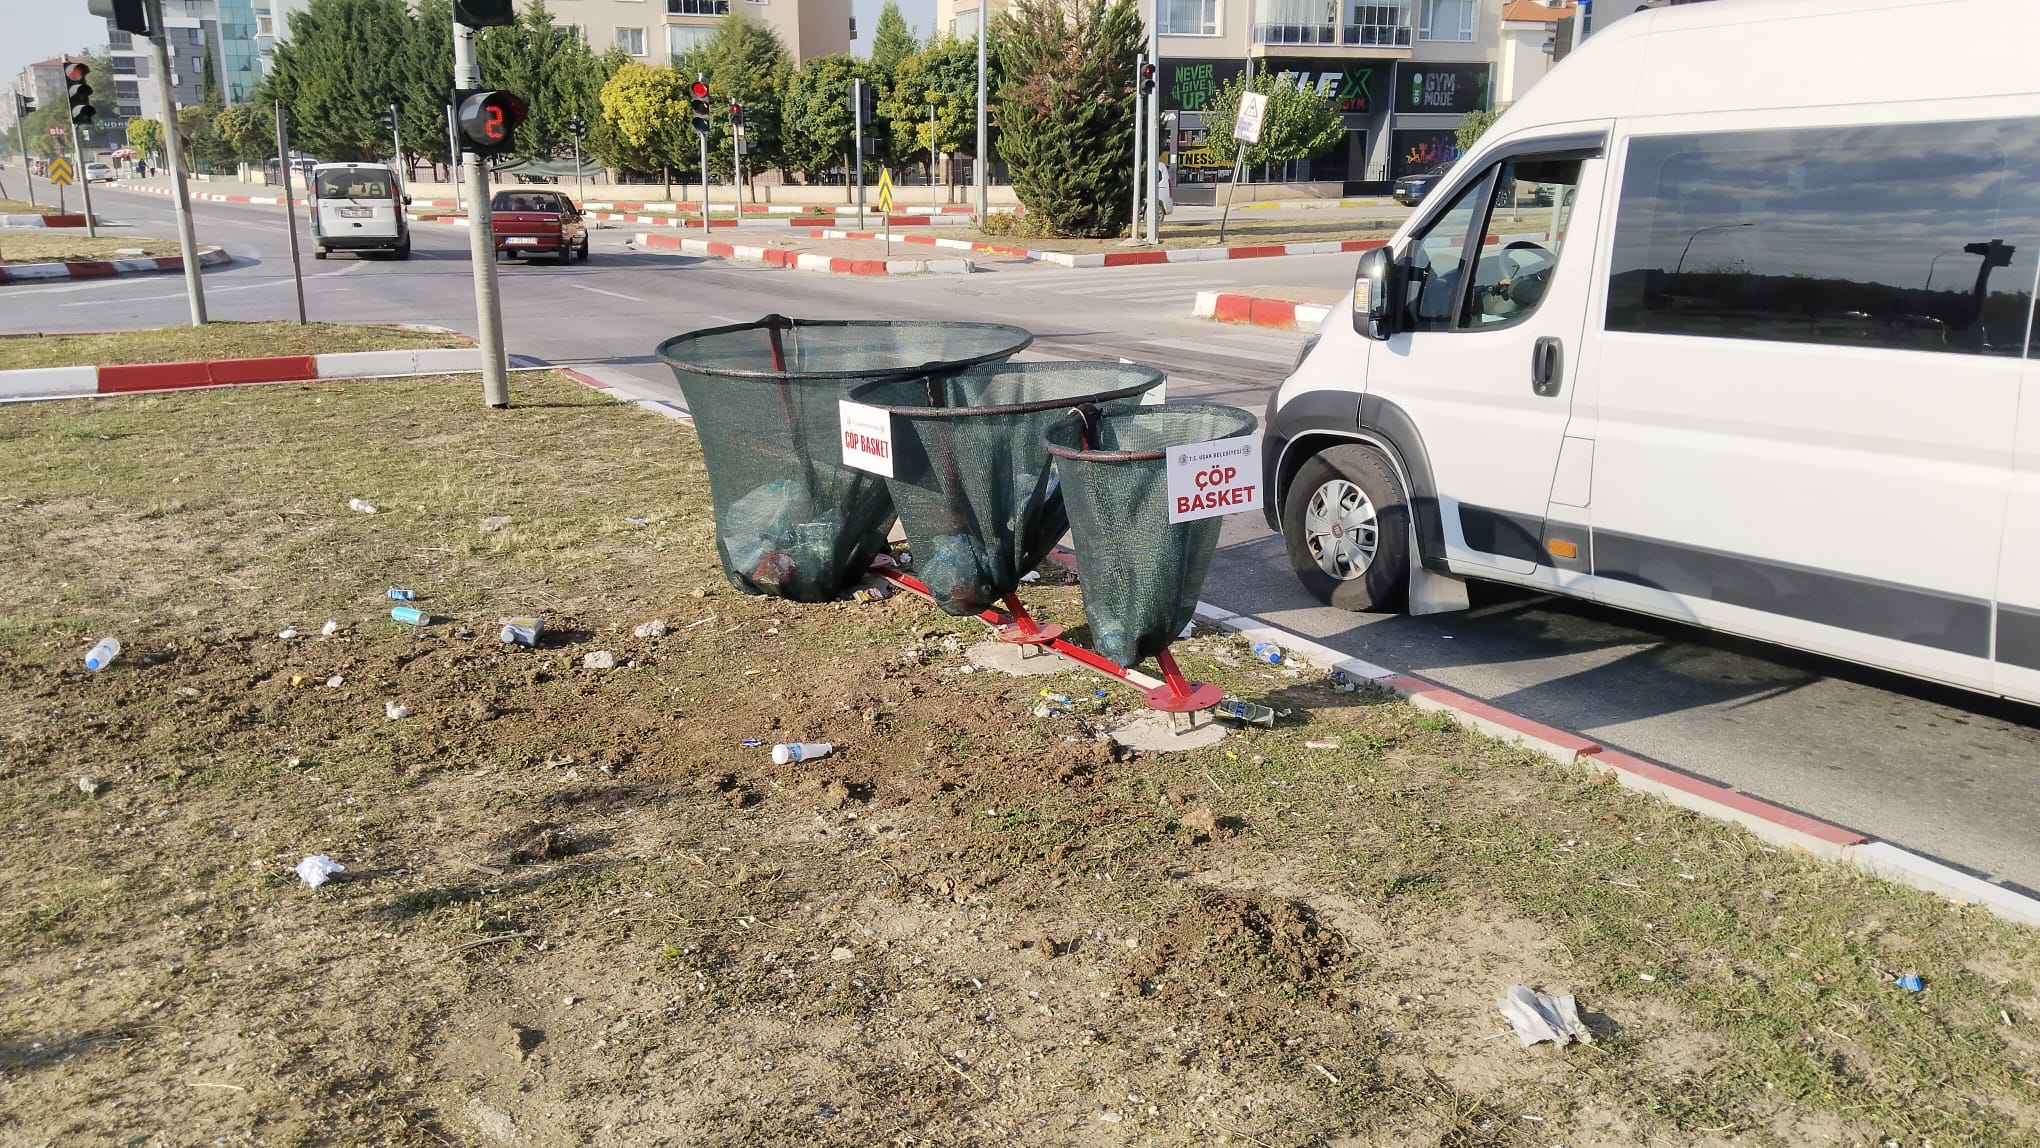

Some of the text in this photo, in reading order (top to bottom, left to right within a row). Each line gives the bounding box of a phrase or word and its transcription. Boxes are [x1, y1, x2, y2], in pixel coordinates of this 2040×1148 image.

[1175, 63, 1213, 83] NEVER
[1425, 72, 1456, 92] GYM
[1183, 79, 1205, 93] GIVE
[1182, 92, 1206, 110] UP
[1341, 98, 1366, 110] GYM
[1424, 91, 1454, 106] MODE
[485, 105, 503, 138] 2
[845, 428, 888, 459] ÇÖP BASKET
[1195, 464, 1237, 491] ÇÖP
[1177, 485, 1256, 514] BASKET
